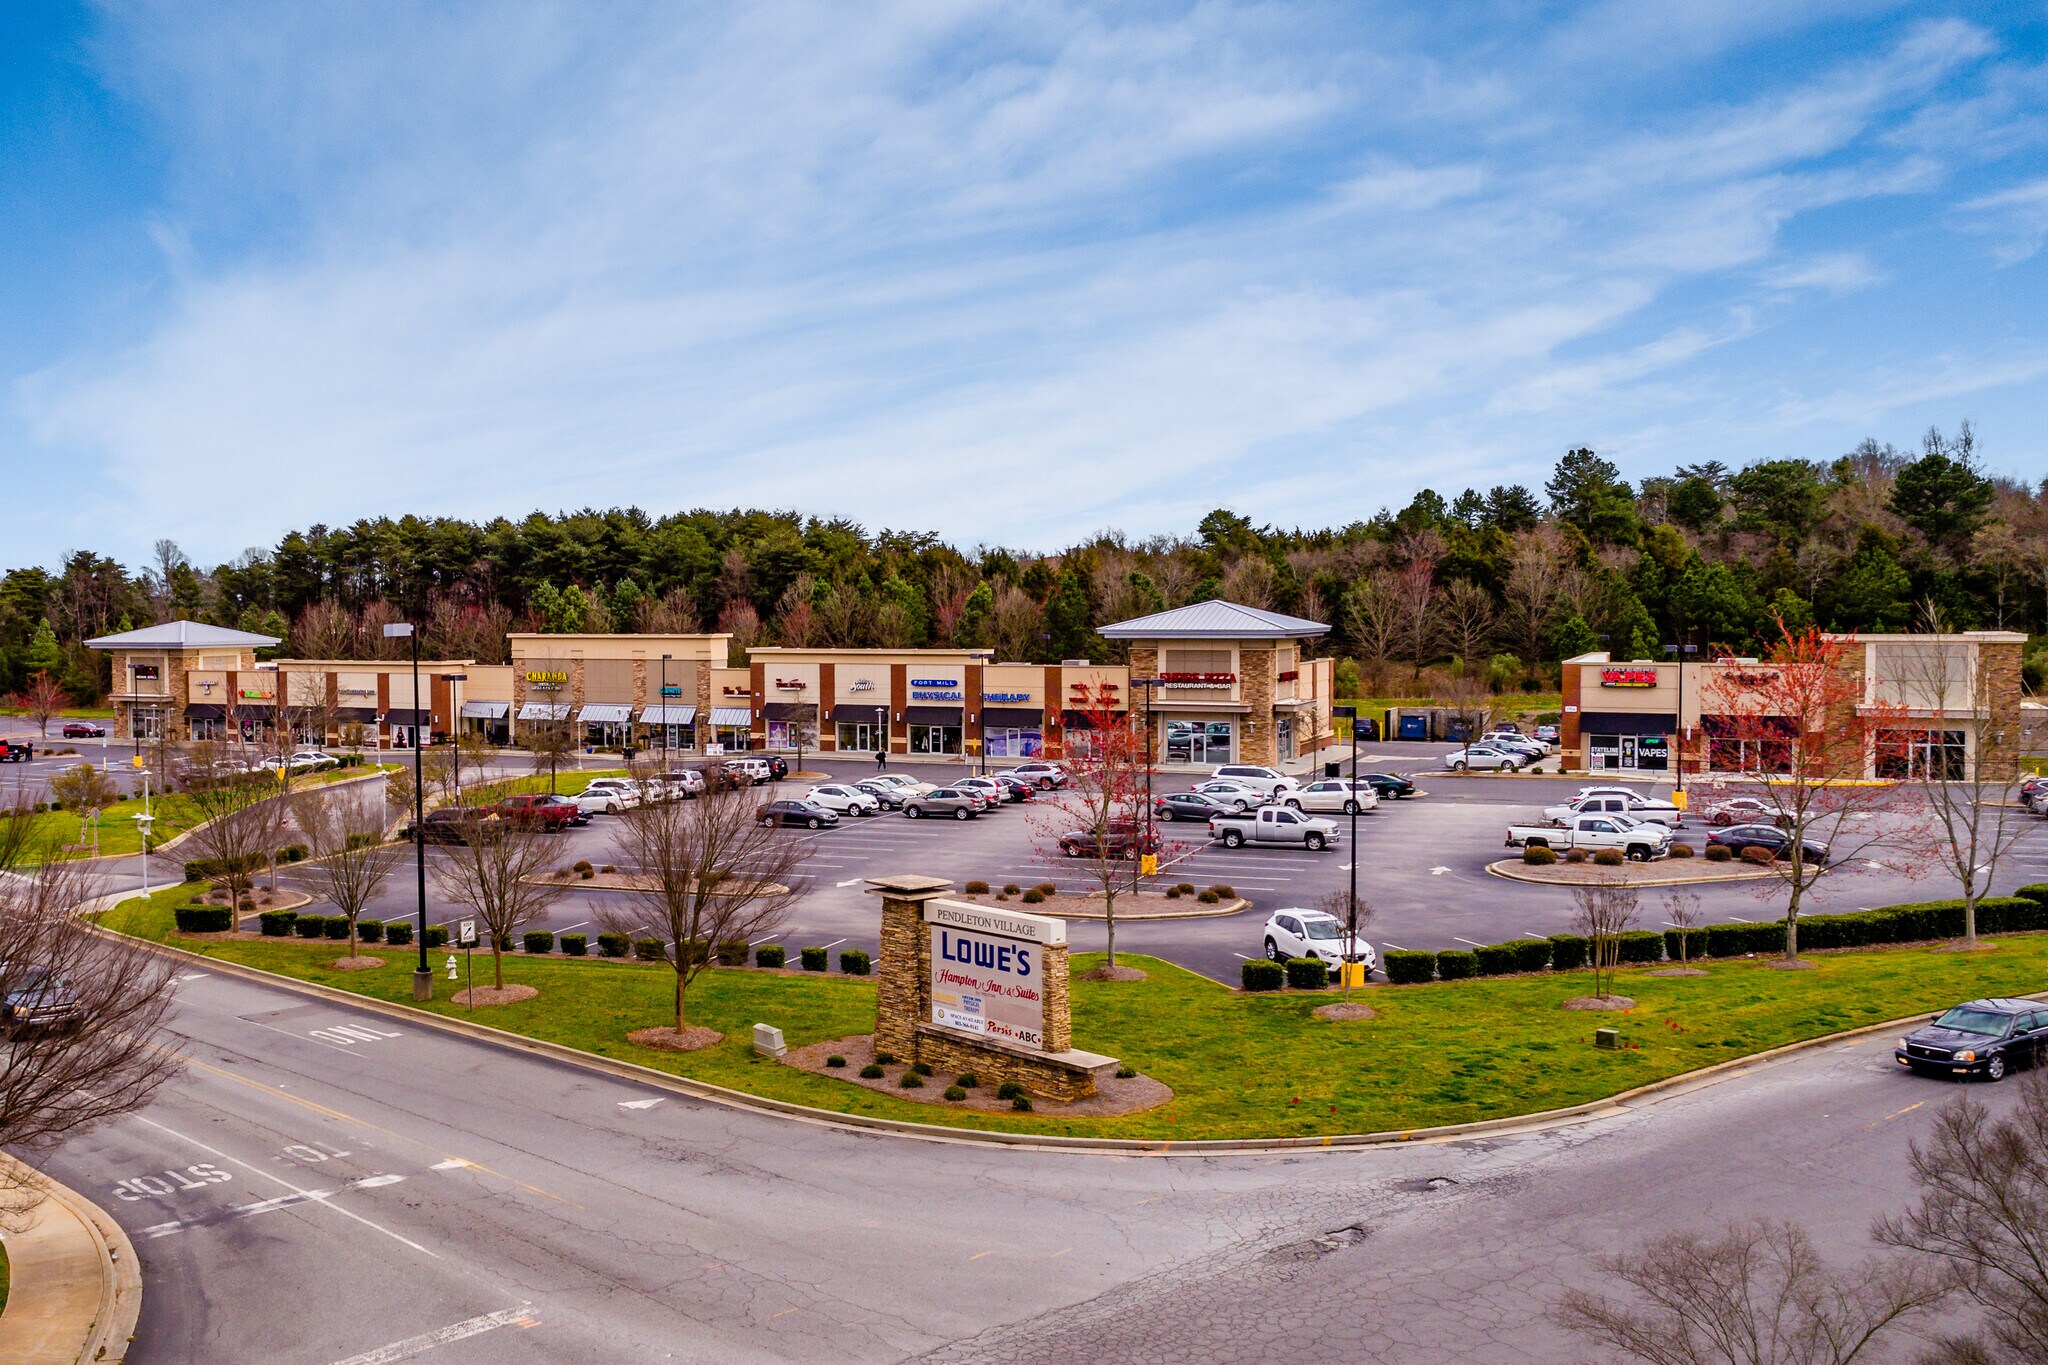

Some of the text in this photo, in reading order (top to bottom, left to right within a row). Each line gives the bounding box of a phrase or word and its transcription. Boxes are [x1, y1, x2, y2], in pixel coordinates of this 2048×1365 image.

[526, 671, 568, 683] CHARANDA
[1204, 672, 1237, 683] PIZZA
[1601, 671, 1657, 683] VAPES
[849, 680, 875, 693] South
[912, 691, 1030, 703] PHYSICAL THERAPY
[1639, 748, 1667, 757] VAPES
[937, 909, 1036, 936] PENDLETON VILLAGE
[942, 930, 1031, 976] LOWE'S
[935, 968, 1040, 1001] Hampton Inn & Suites
[963, 999, 980, 1009] PHYSICAL
[987, 1020, 1012, 1036] Persis
[111, 1163, 233, 1202] STOP
